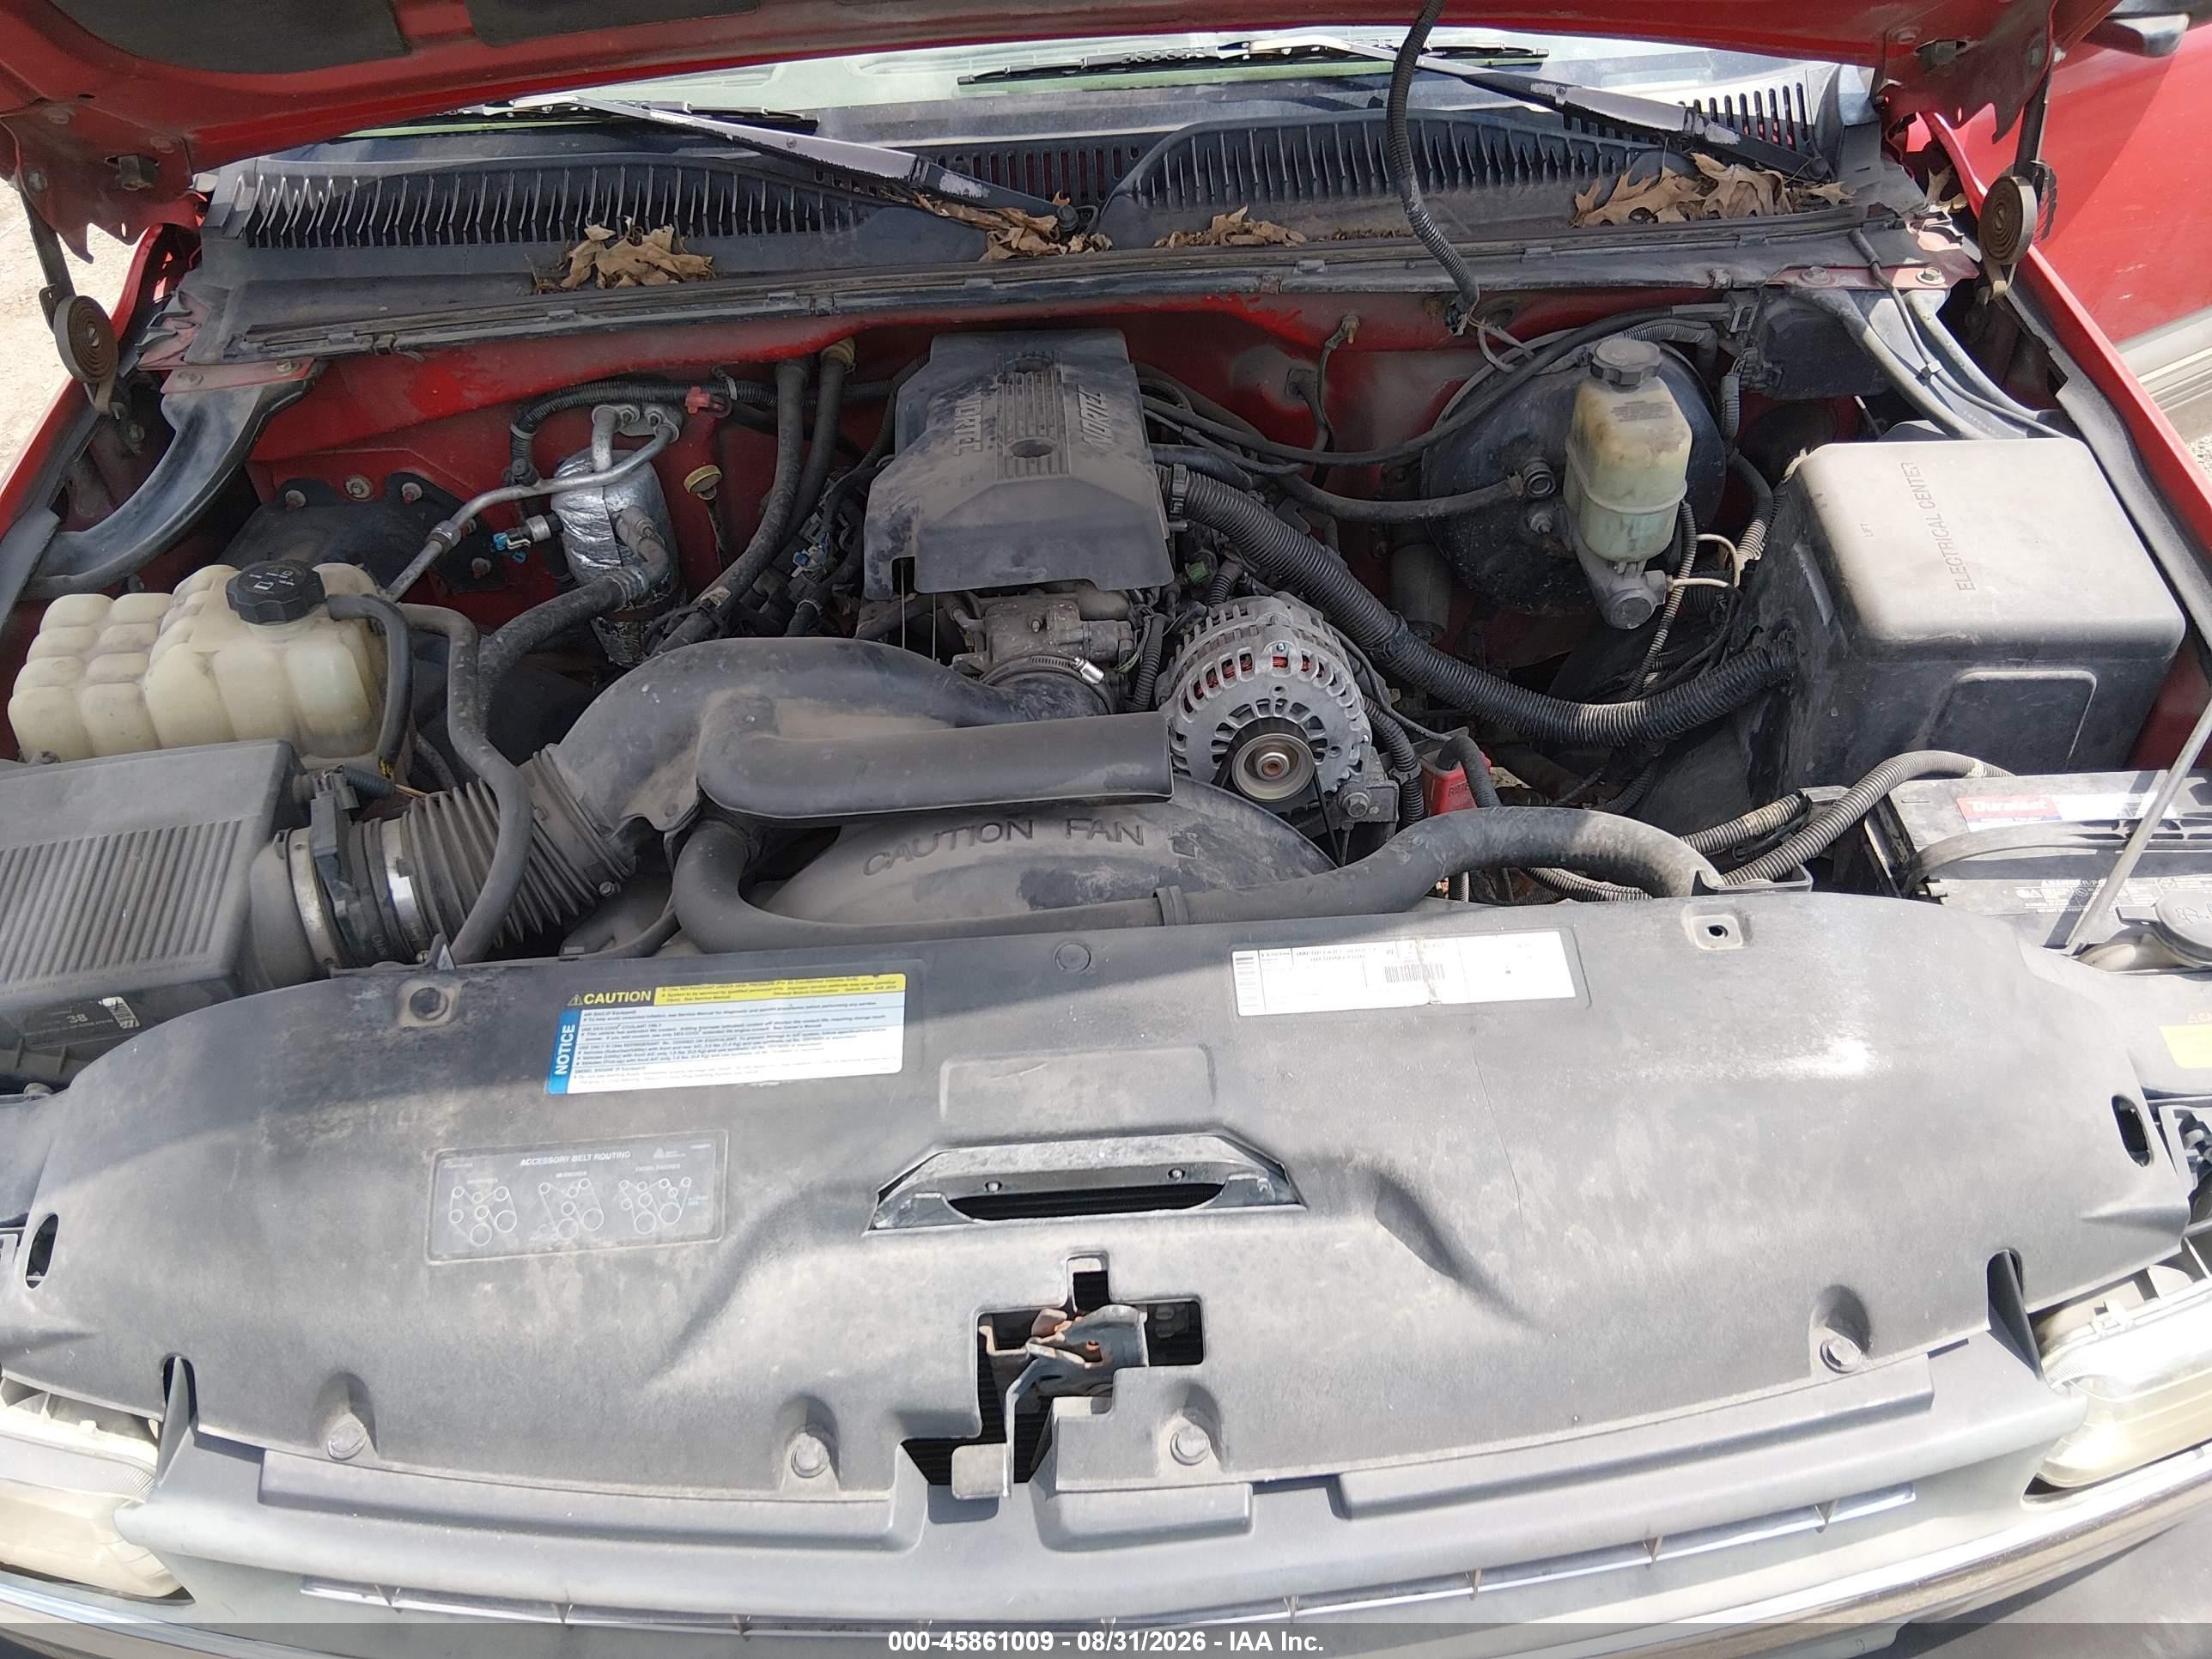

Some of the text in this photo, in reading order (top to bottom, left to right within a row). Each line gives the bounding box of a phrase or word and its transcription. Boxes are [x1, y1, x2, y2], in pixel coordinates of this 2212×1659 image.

[1859, 522, 1875, 538] LIFT
[1899, 460, 1977, 592] ELECTRICAL CENTER
[862, 817, 1146, 876] CAUTION FAN
[583, 990, 652, 1006] CAUTION
[554, 1024, 576, 1076] NOTICE
